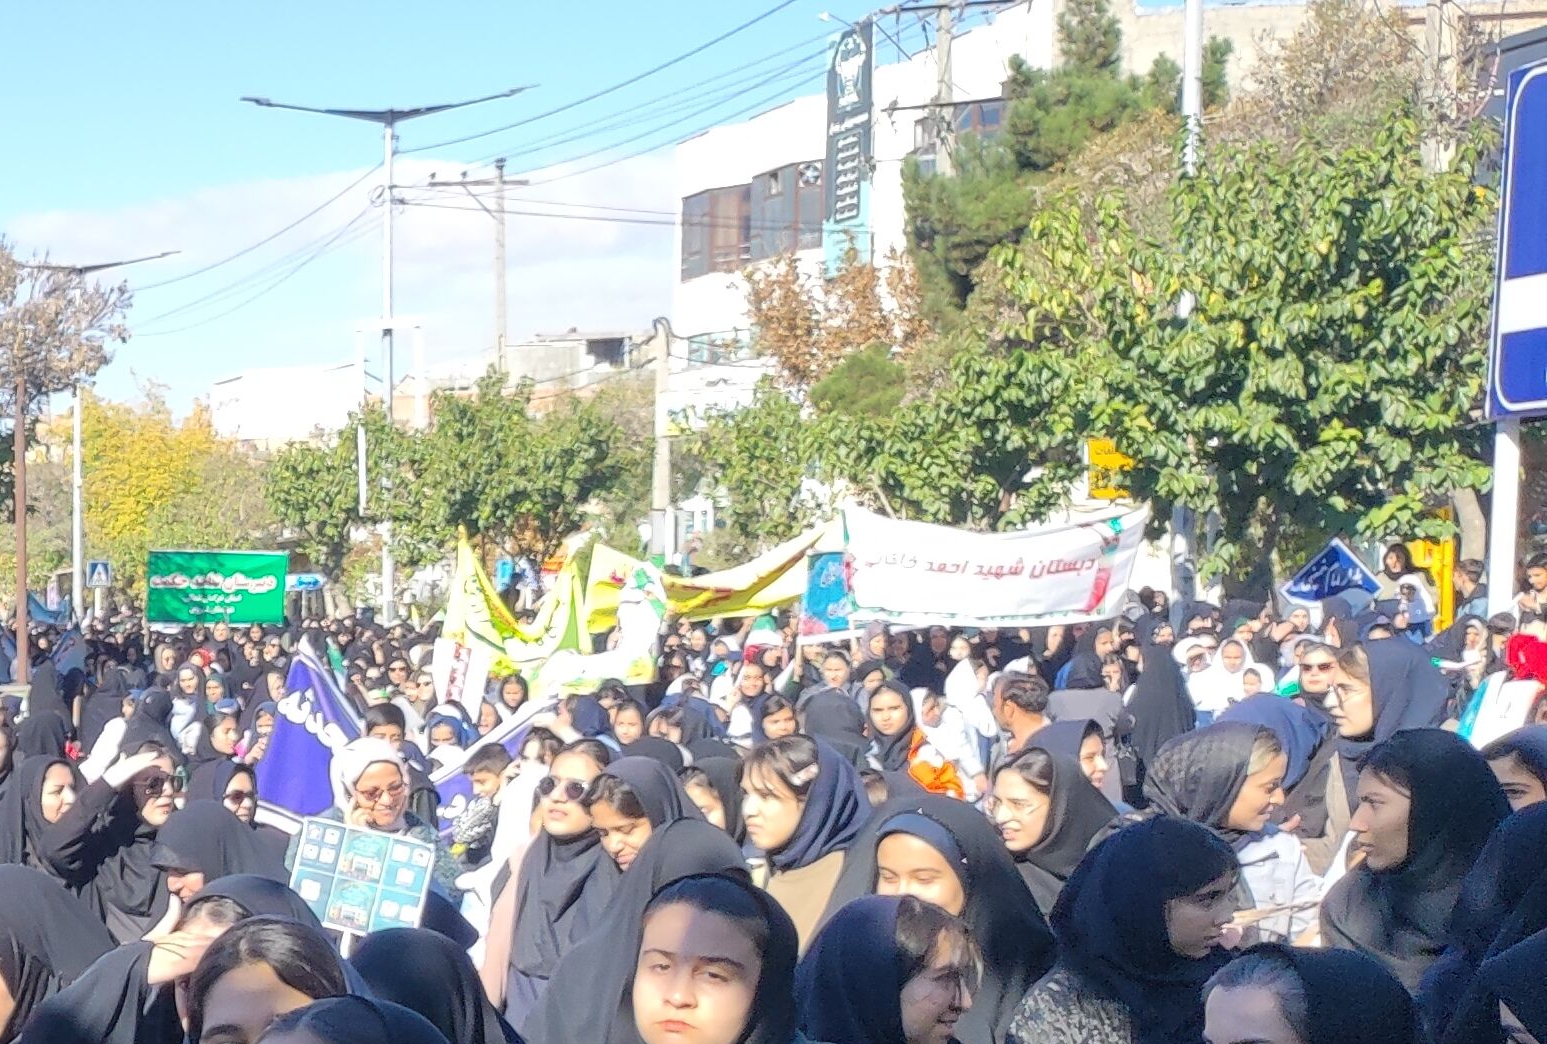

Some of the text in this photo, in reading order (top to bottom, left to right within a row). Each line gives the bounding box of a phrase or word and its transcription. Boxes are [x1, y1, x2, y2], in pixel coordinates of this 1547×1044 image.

[924, 560, 970, 574] احمد
[974, 556, 1024, 580] شهید
[1028, 557, 1097, 579] دبستان
